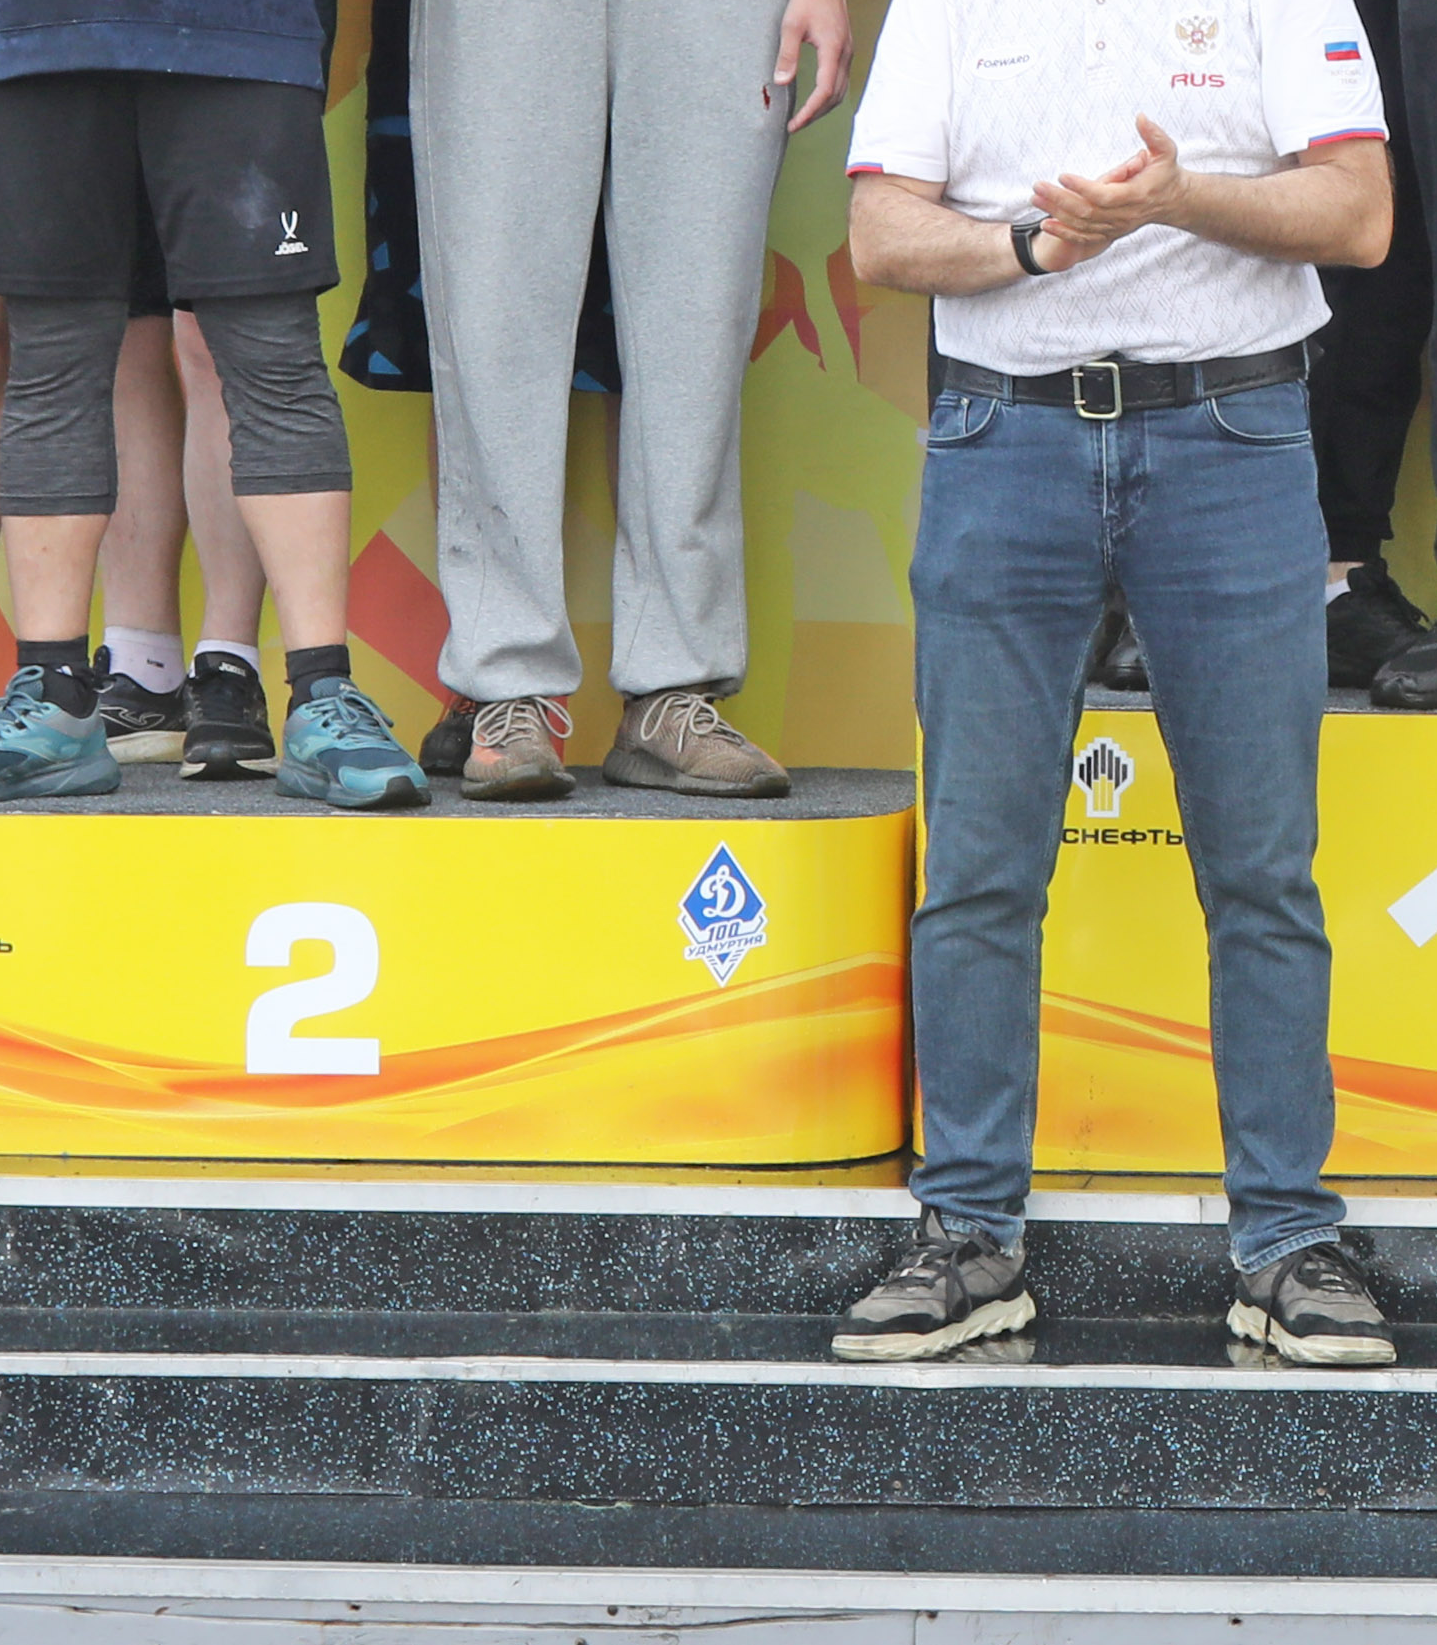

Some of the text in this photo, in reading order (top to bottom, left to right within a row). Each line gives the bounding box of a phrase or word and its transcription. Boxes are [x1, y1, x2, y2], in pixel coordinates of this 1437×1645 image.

[1171, 73, 1225, 89] RUS
[1062, 828, 1184, 846] СНЕФТЬ
[708, 922, 740, 943] 100
[687, 933, 764, 957] УДМУРТИЯ
[245, 901, 381, 1075] 2
